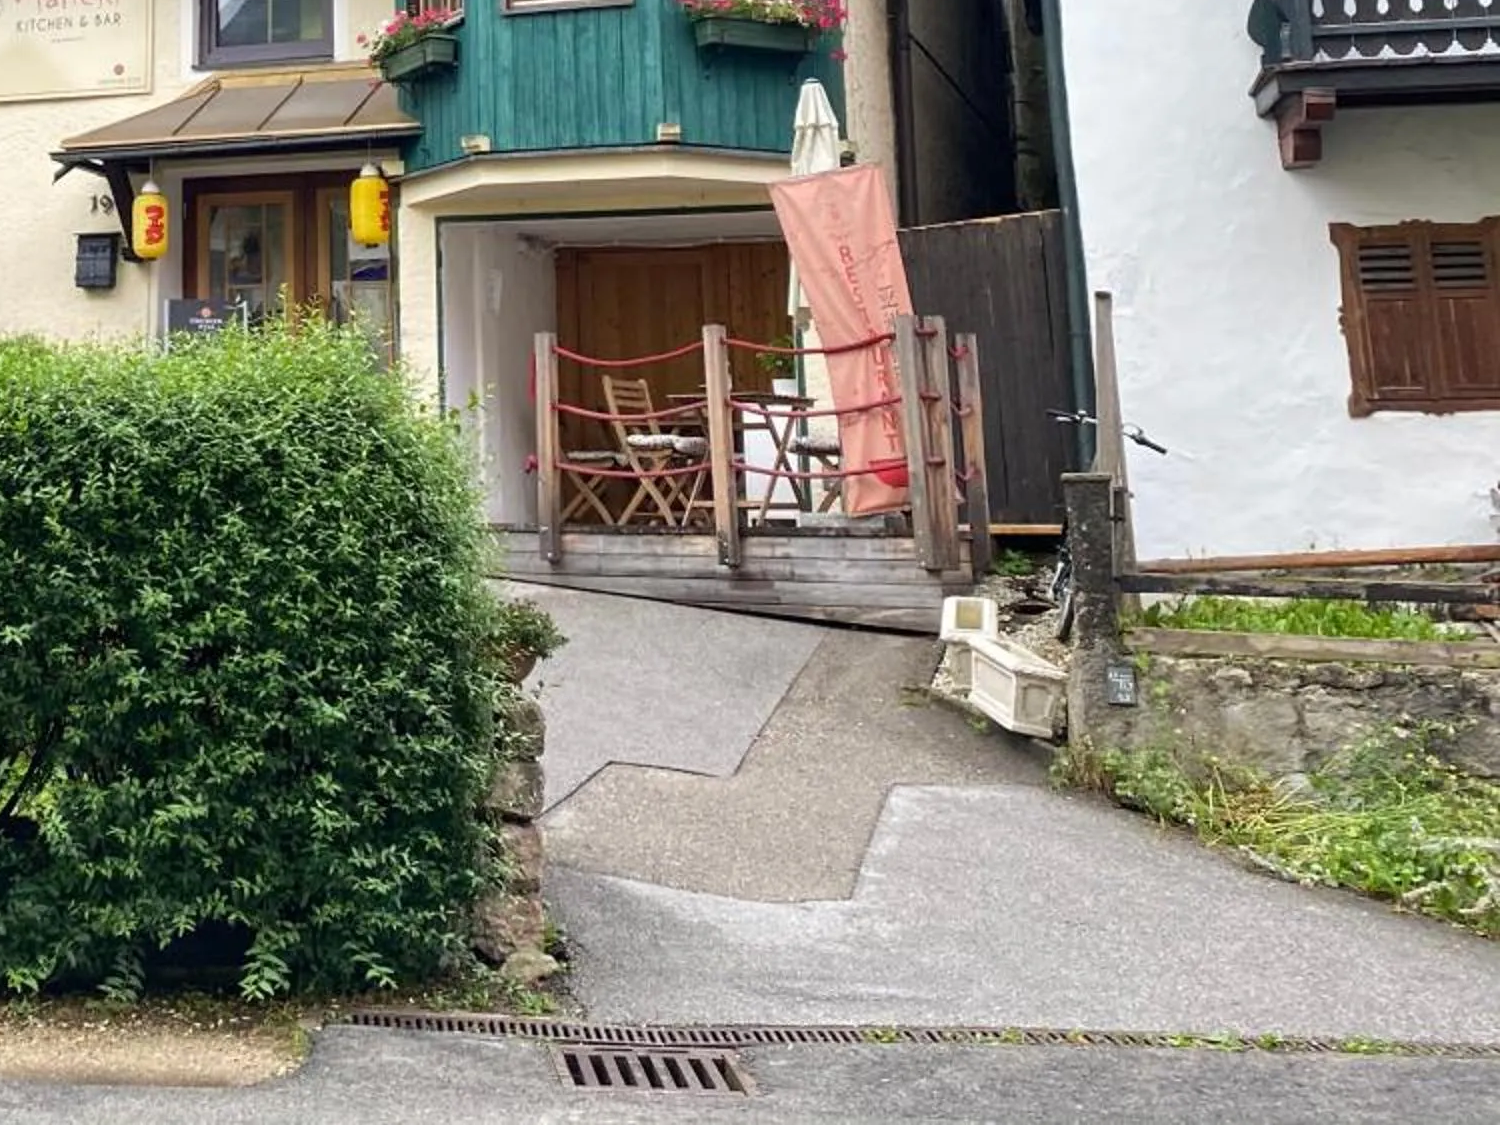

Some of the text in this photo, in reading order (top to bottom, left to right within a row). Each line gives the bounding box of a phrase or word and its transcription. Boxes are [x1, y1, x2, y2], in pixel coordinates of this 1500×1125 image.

[16, 17, 74, 33] KITCHEN
[95, 12, 122, 28] BAR
[90, 194, 115, 215] 19
